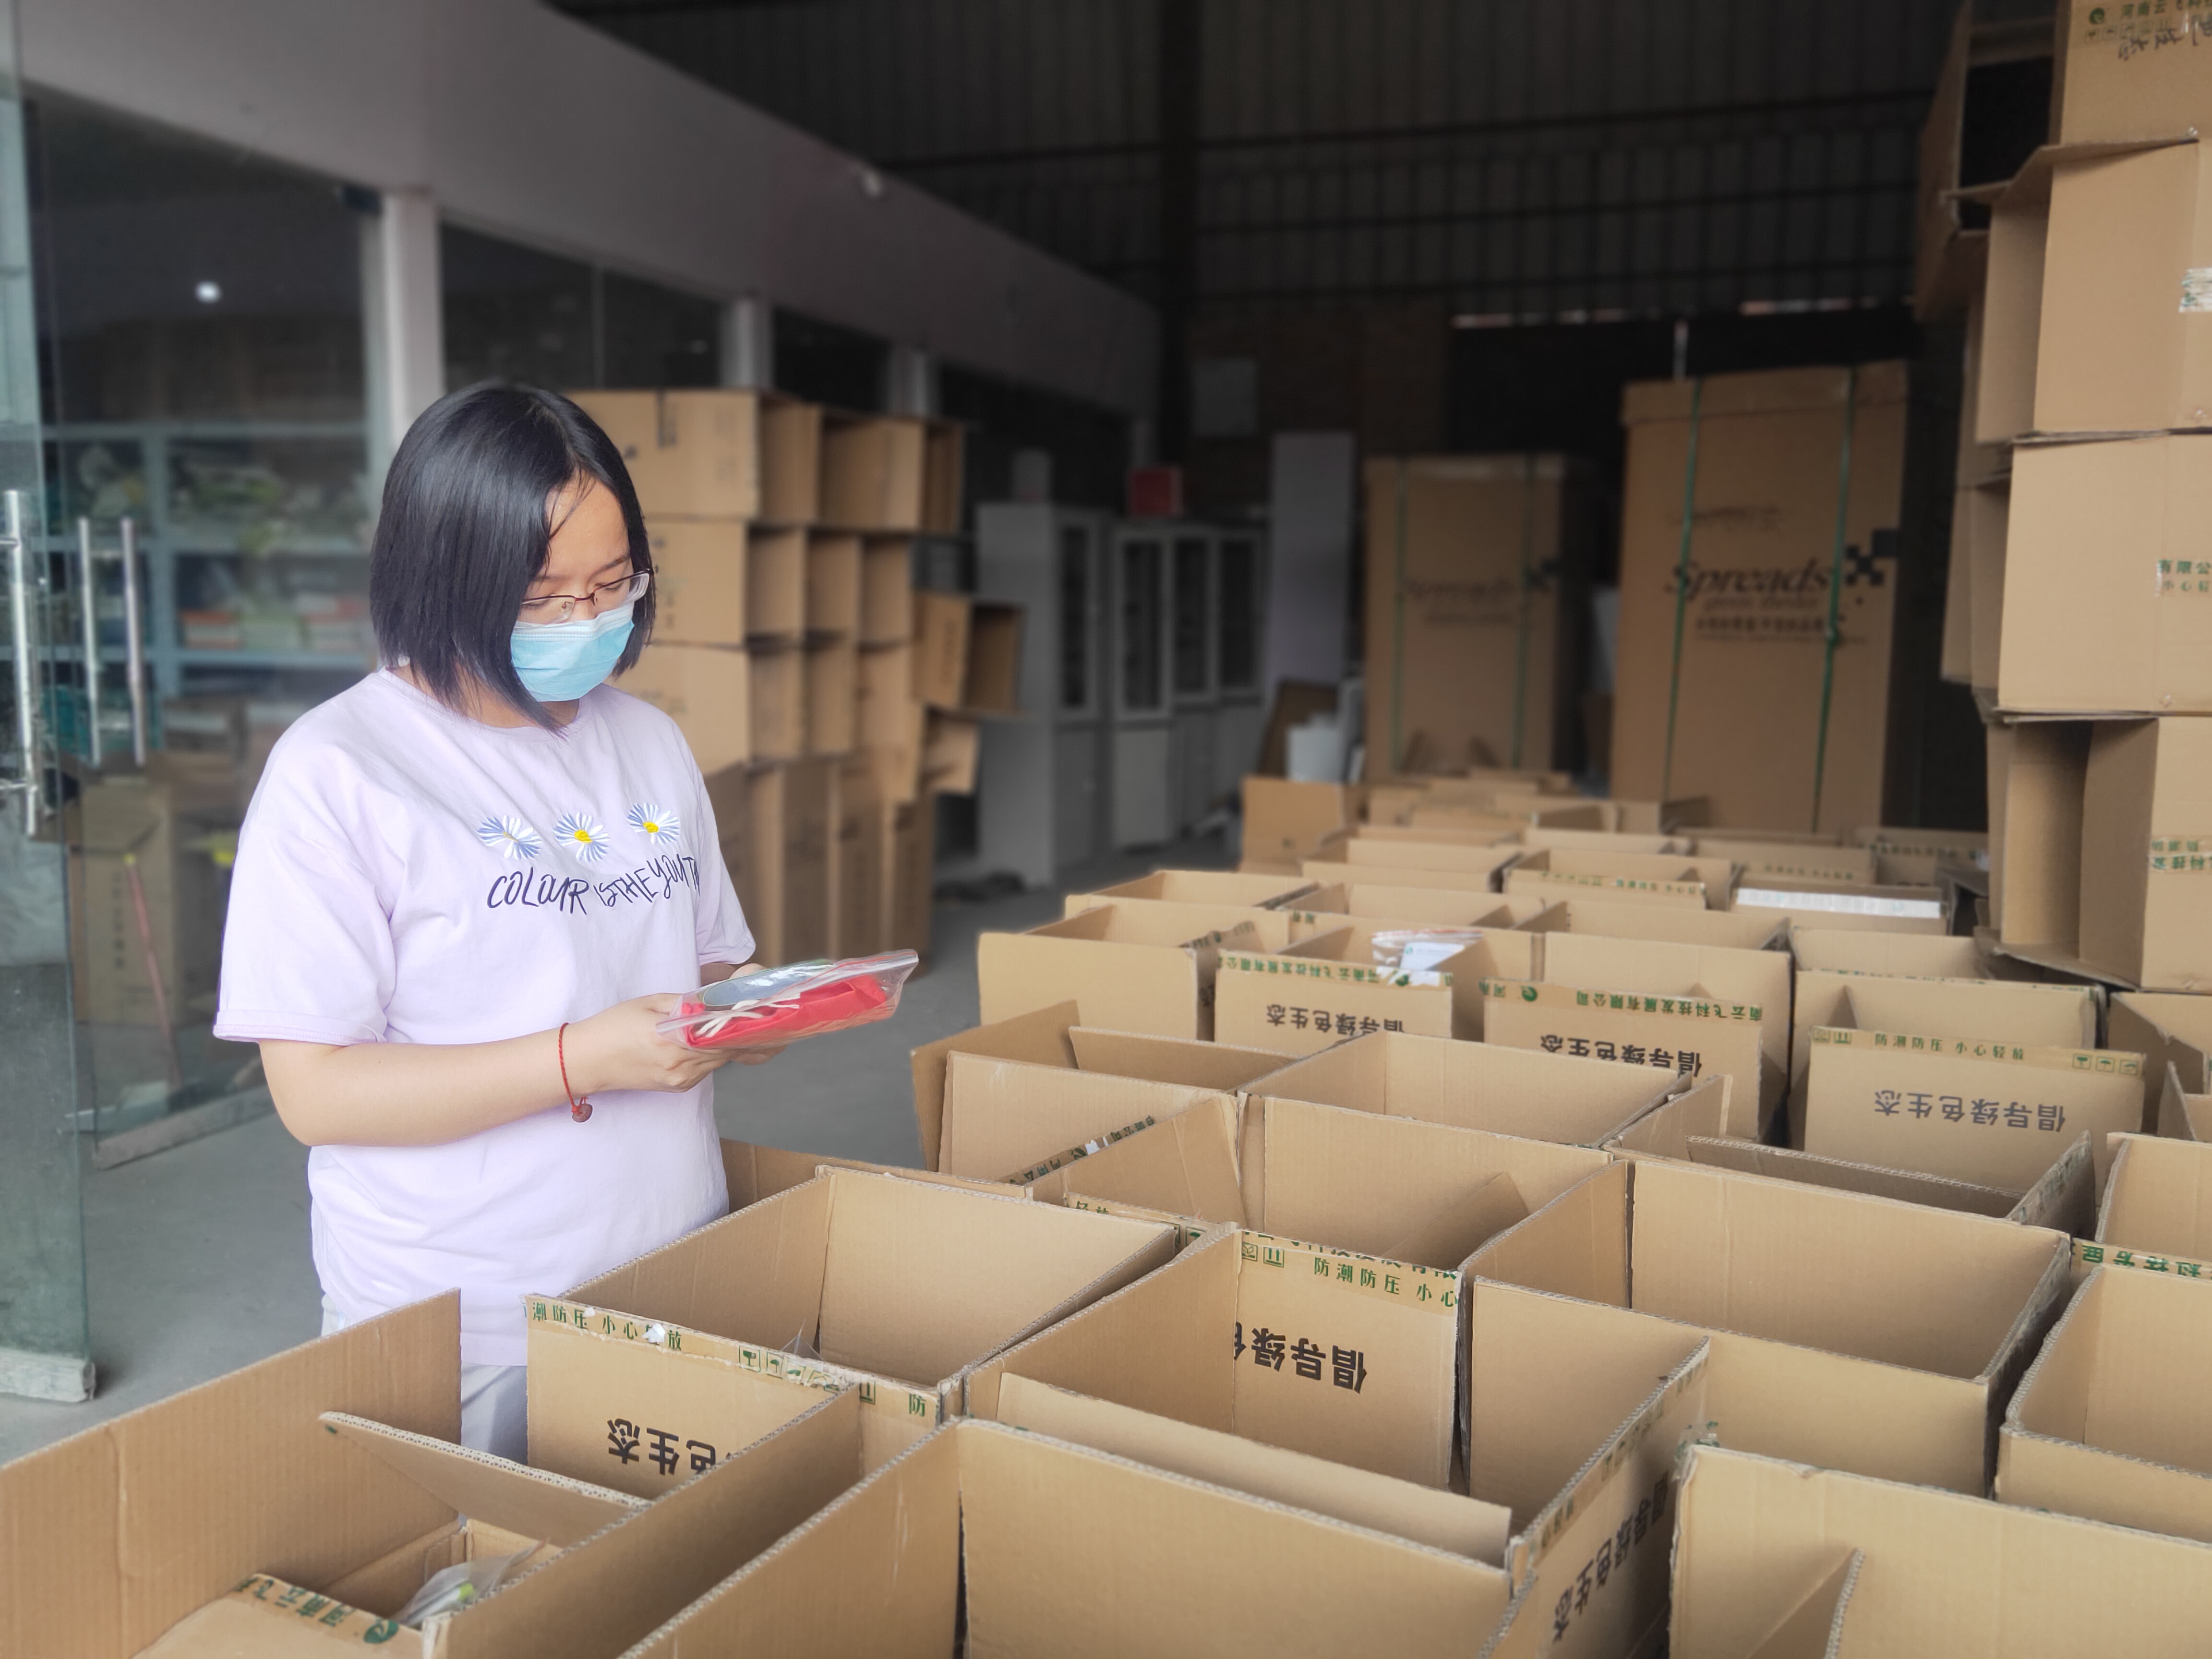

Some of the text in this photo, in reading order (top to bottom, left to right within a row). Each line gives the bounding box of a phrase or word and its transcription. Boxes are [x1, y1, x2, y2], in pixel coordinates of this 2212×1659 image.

[487, 866, 589, 914] COLOUR
[1875, 1033, 1943, 1052] 防潮防压
[1874, 1089, 2067, 1132] 倡导绿色生态
[1313, 1256, 1401, 1296] 防潮防压
[602, 1315, 682, 1351] 小心放
